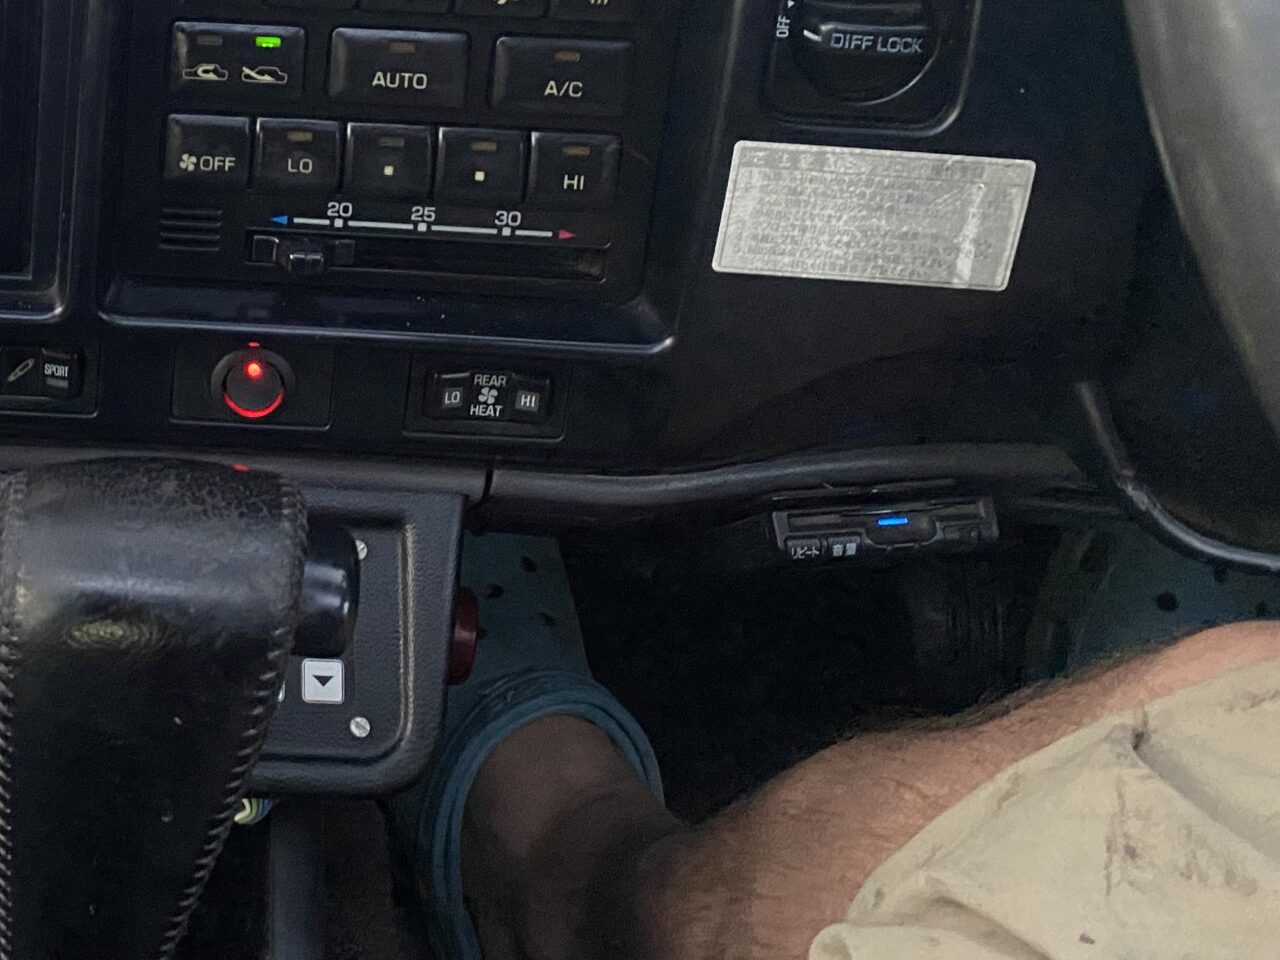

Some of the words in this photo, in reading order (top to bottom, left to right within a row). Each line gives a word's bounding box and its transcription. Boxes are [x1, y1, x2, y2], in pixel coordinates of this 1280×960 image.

[776, 14, 790, 38] OFF
[830, 33, 874, 50] DIFF
[877, 36, 923, 53] LOCK
[372, 71, 428, 89] AUTO
[543, 80, 583, 97] A/C
[200, 155, 236, 172] OFF
[287, 158, 313, 174] LO
[563, 174, 585, 190] HI
[327, 202, 353, 217] 20
[411, 206, 436, 222] 25
[494, 210, 521, 227] 30
[44, 363, 69, 378] SPORT
[474, 374, 507, 387] REAR
[444, 391, 460, 404] LO
[521, 394, 536, 408] HI
[470, 404, 503, 417] HEAT
